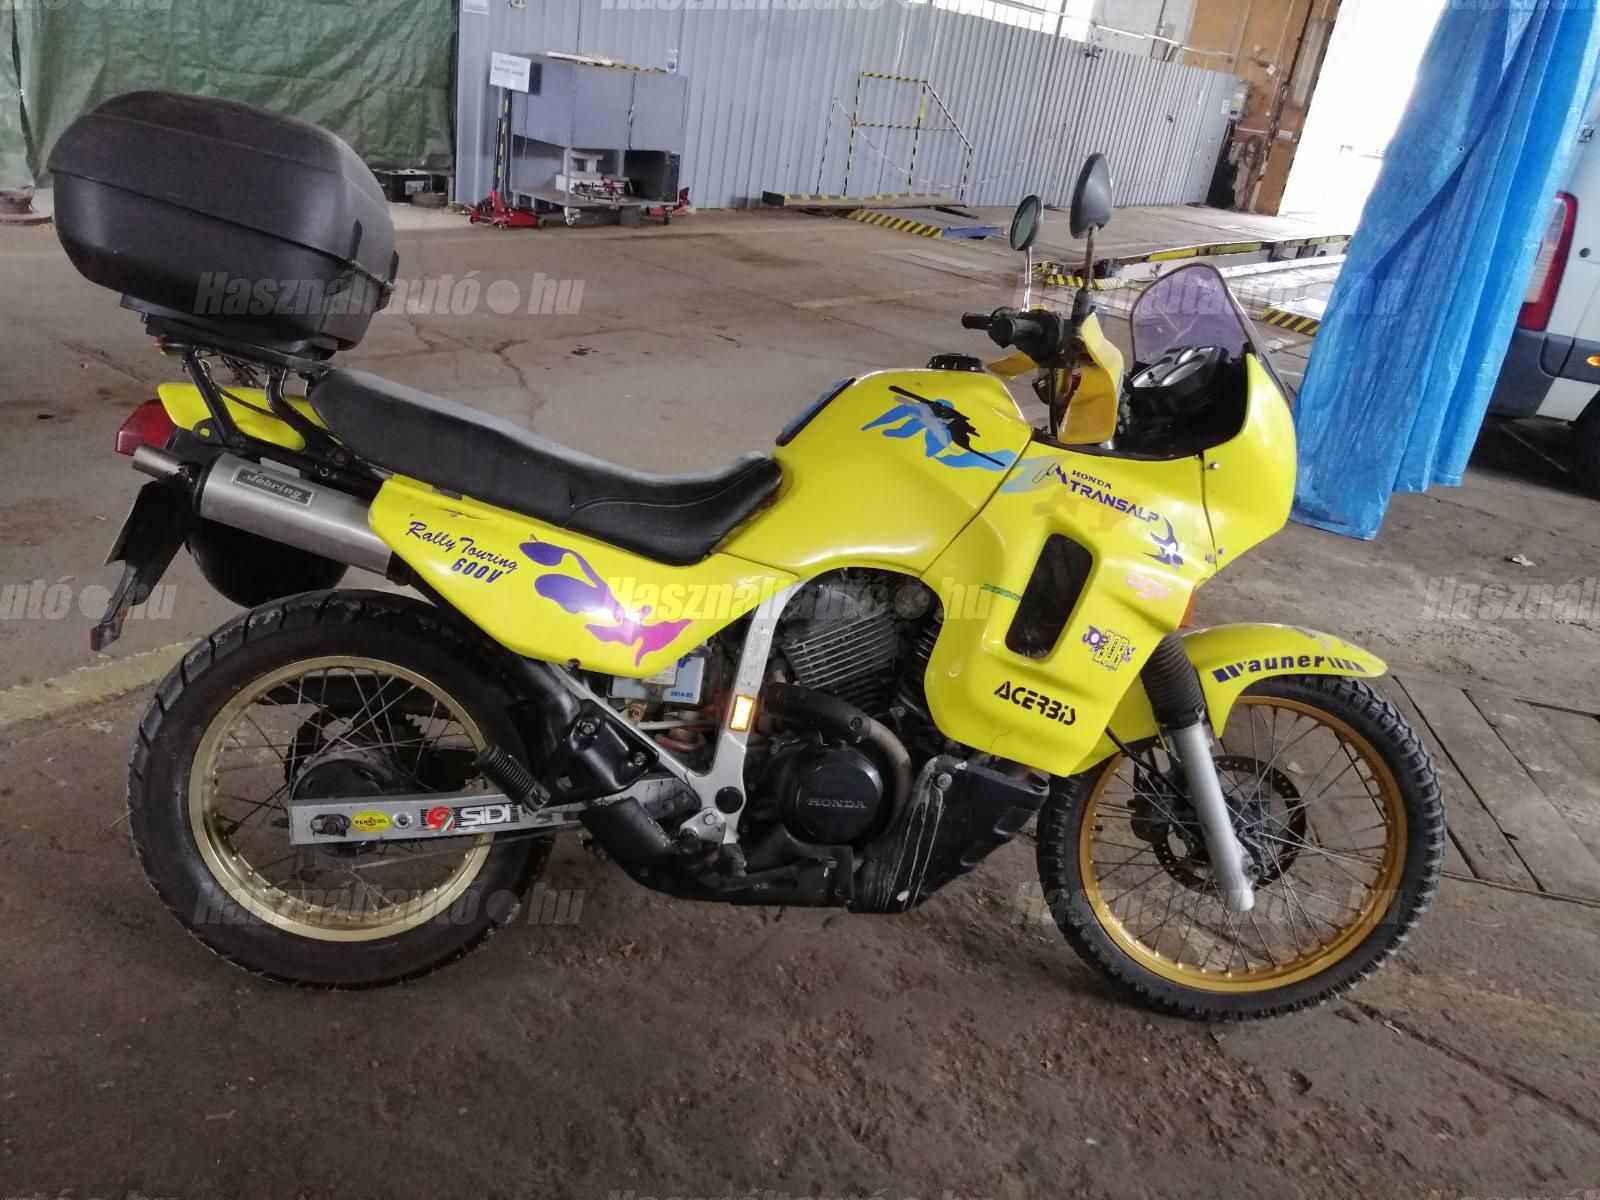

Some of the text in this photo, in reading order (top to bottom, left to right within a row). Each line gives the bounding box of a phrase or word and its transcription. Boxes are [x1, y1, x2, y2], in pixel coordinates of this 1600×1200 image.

[1071, 469, 1112, 490] HONDA
[1069, 479, 1160, 523] TRANSALP
[405, 521, 518, 575] Rally Touring
[451, 557, 504, 584] 600V
[807, 797, 867, 809] HONDA
